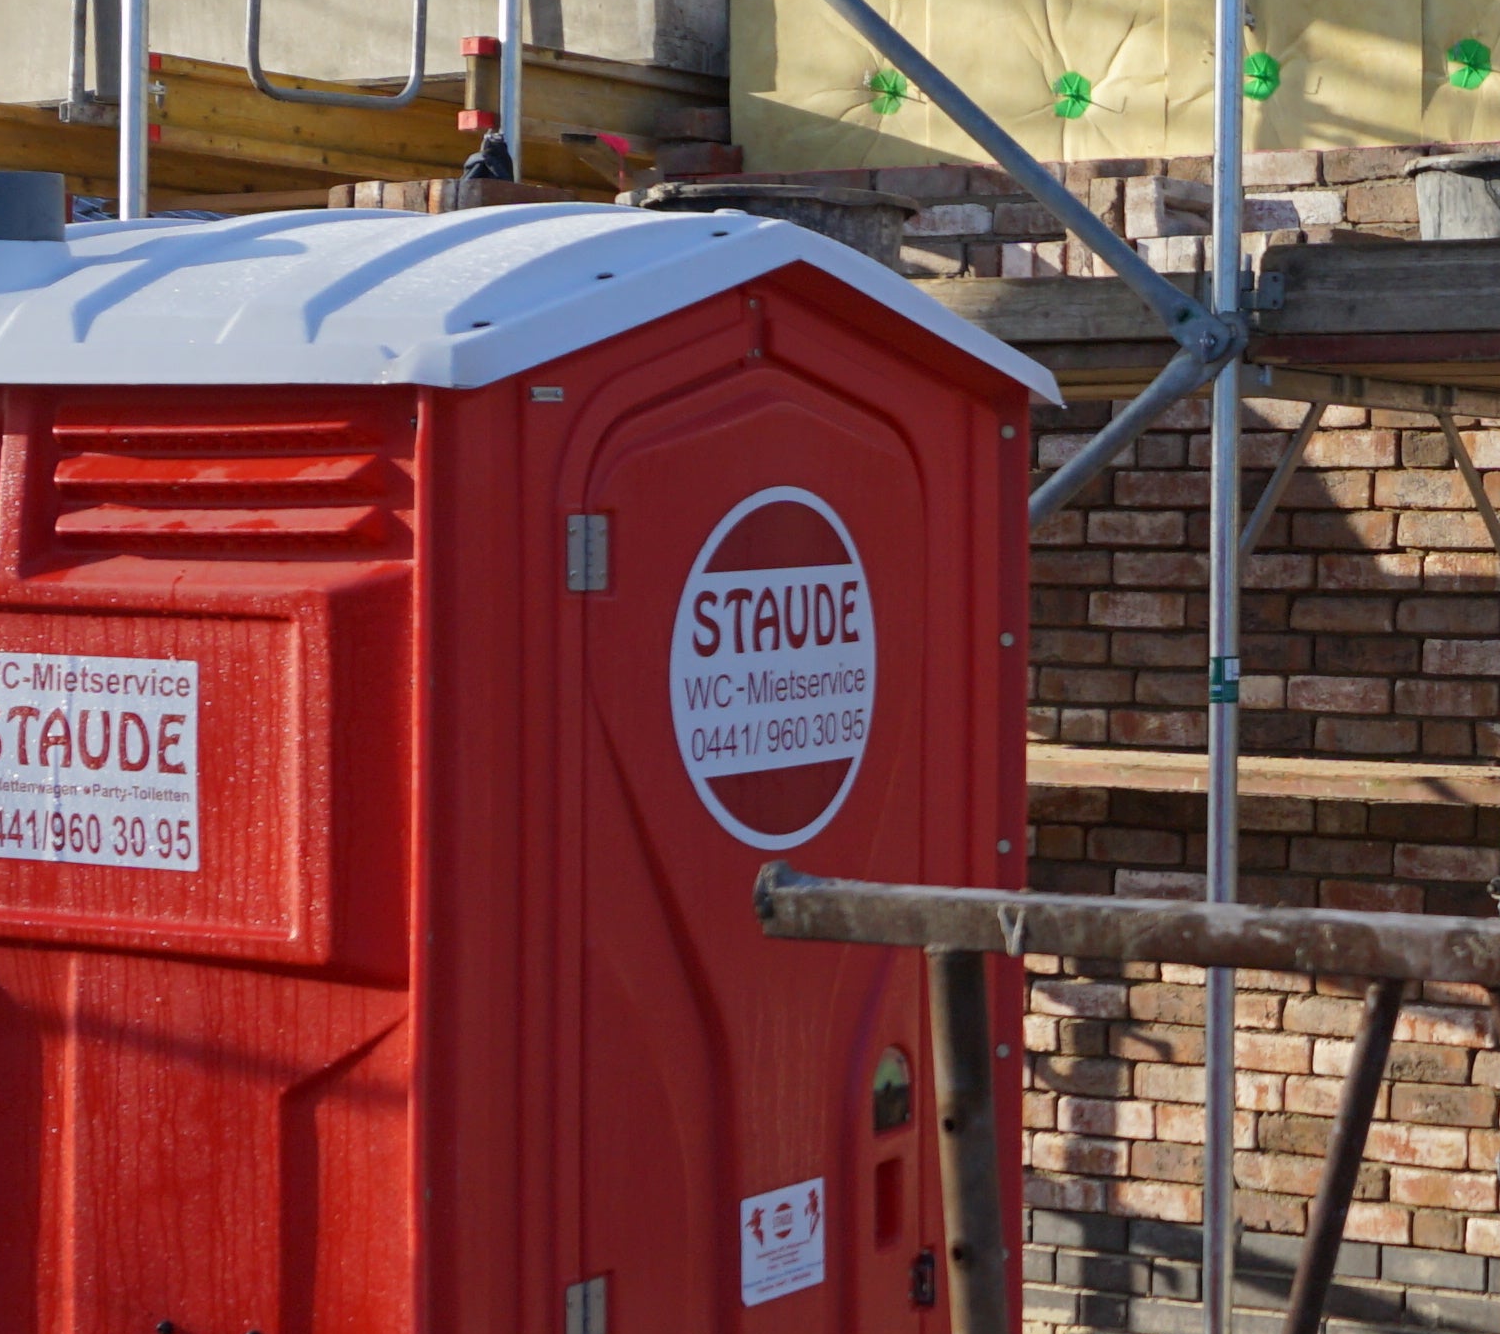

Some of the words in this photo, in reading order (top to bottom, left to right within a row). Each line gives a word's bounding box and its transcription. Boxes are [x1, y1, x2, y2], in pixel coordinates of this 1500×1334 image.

[692, 581, 860, 657] STAUDE
[685, 663, 866, 710] WC-Mietservice
[114, 816, 146, 857] 30
[157, 819, 192, 860] 95
